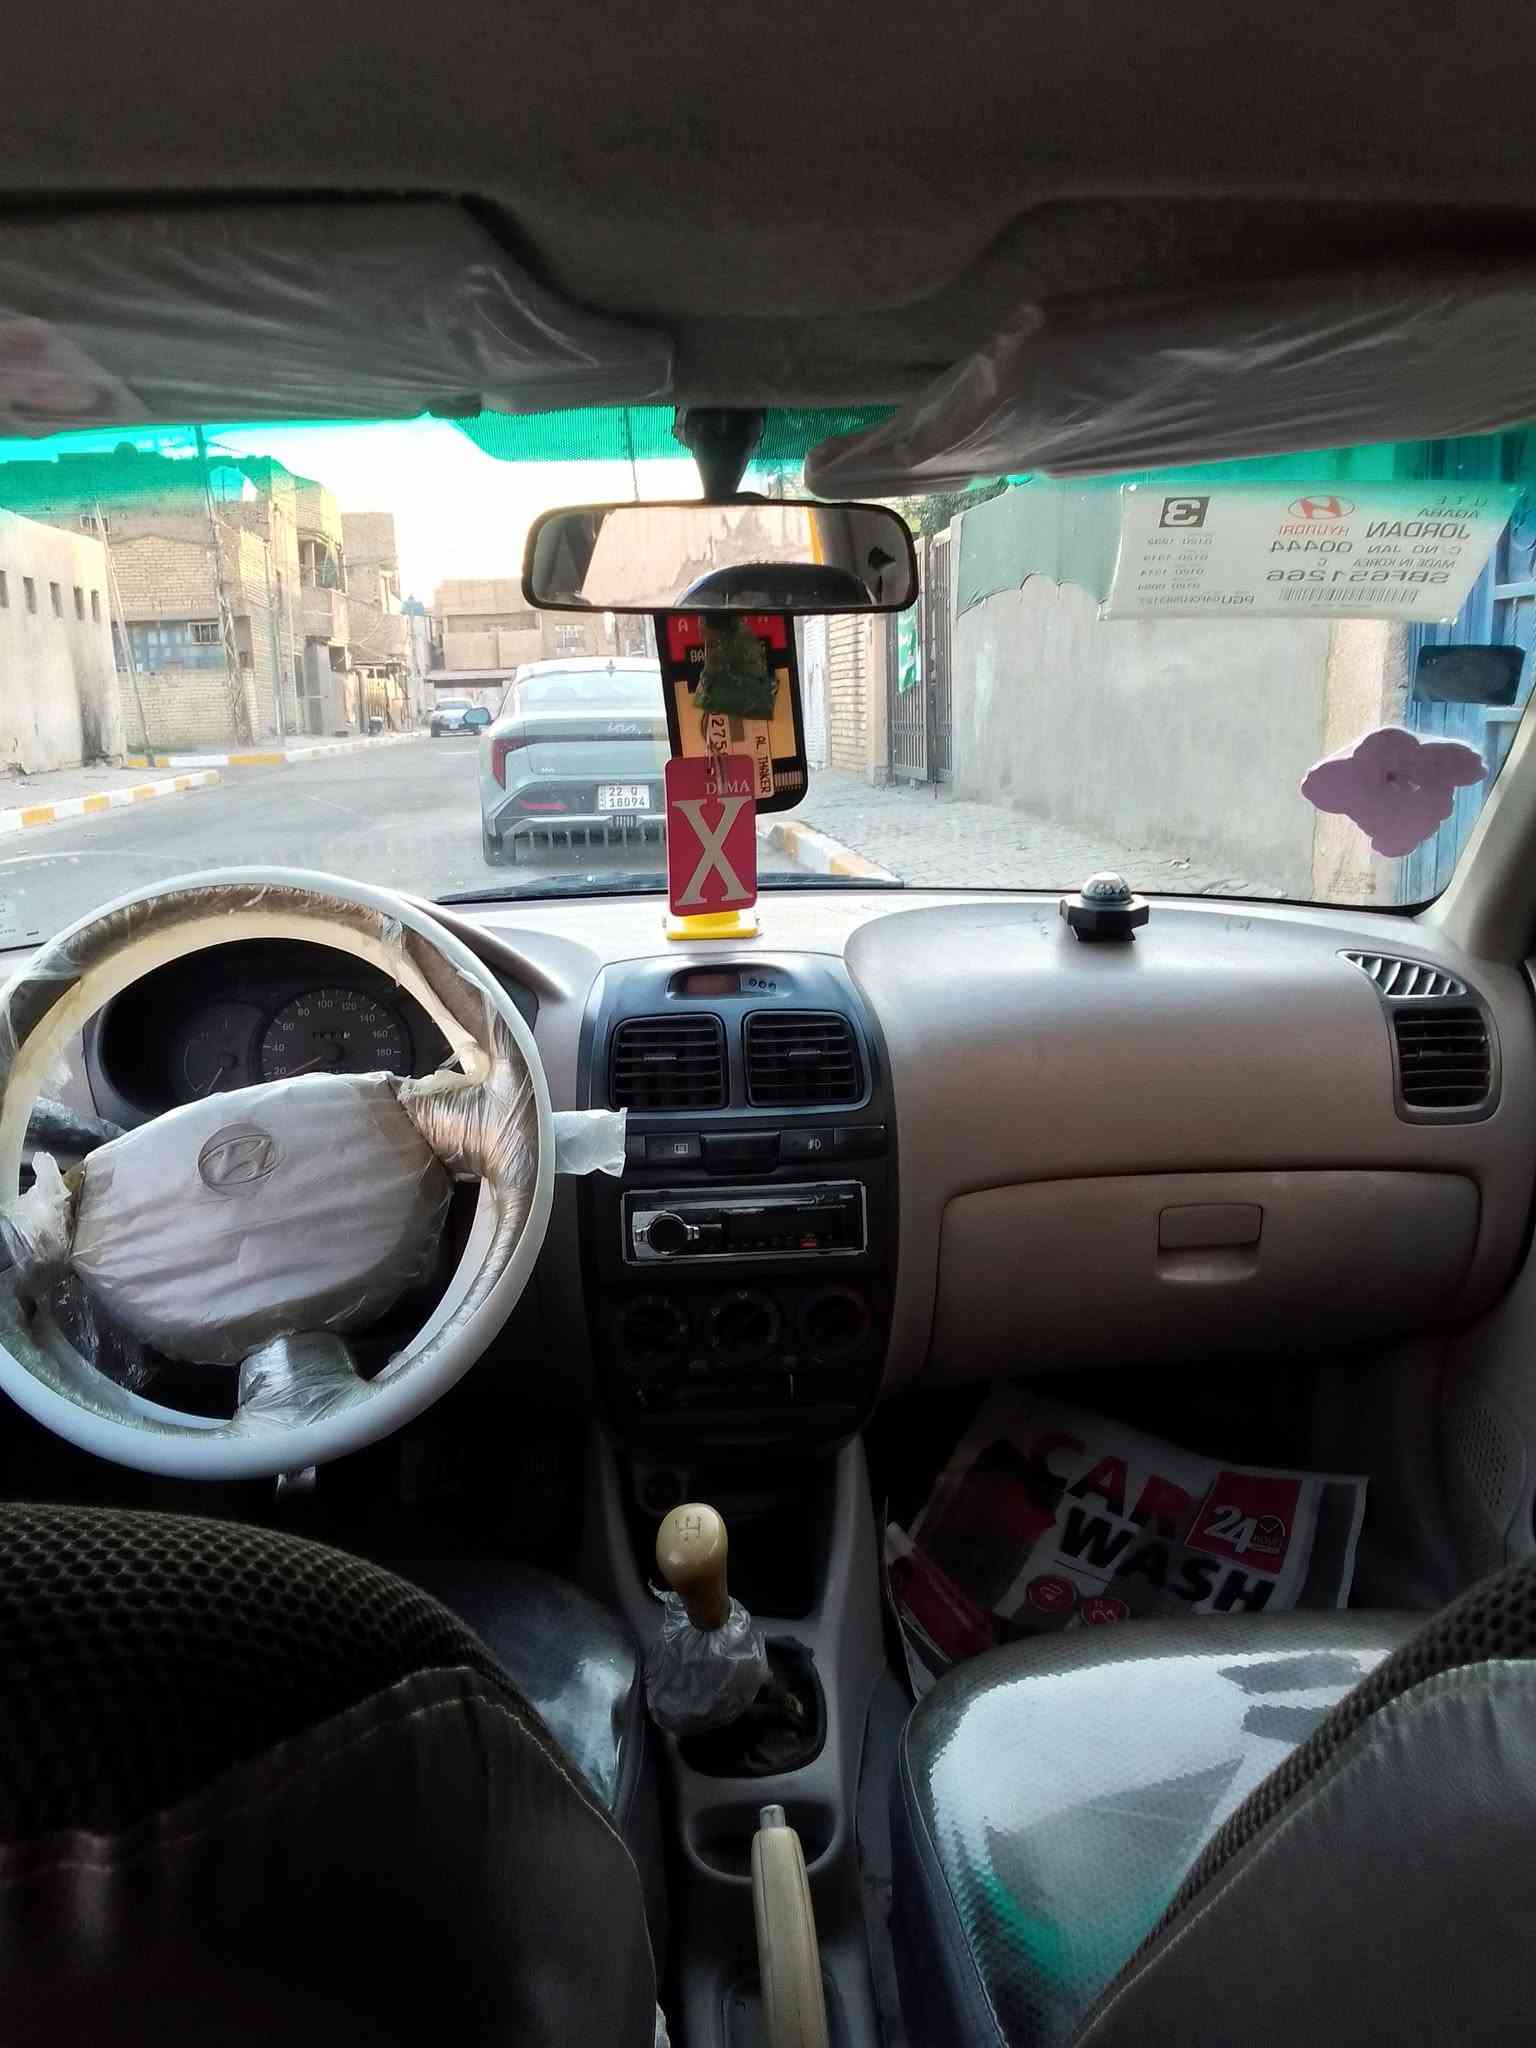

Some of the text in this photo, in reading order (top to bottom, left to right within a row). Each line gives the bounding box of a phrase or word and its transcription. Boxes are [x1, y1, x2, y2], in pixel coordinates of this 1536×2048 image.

[608, 786, 623, 797] 22
[671, 796, 754, 906] X
[317, 999, 333, 1009] 100
[1027, 1432, 1190, 1536] CAR
[1061, 1507, 1276, 1612] WASH
[1203, 1504, 1258, 1555] 24
